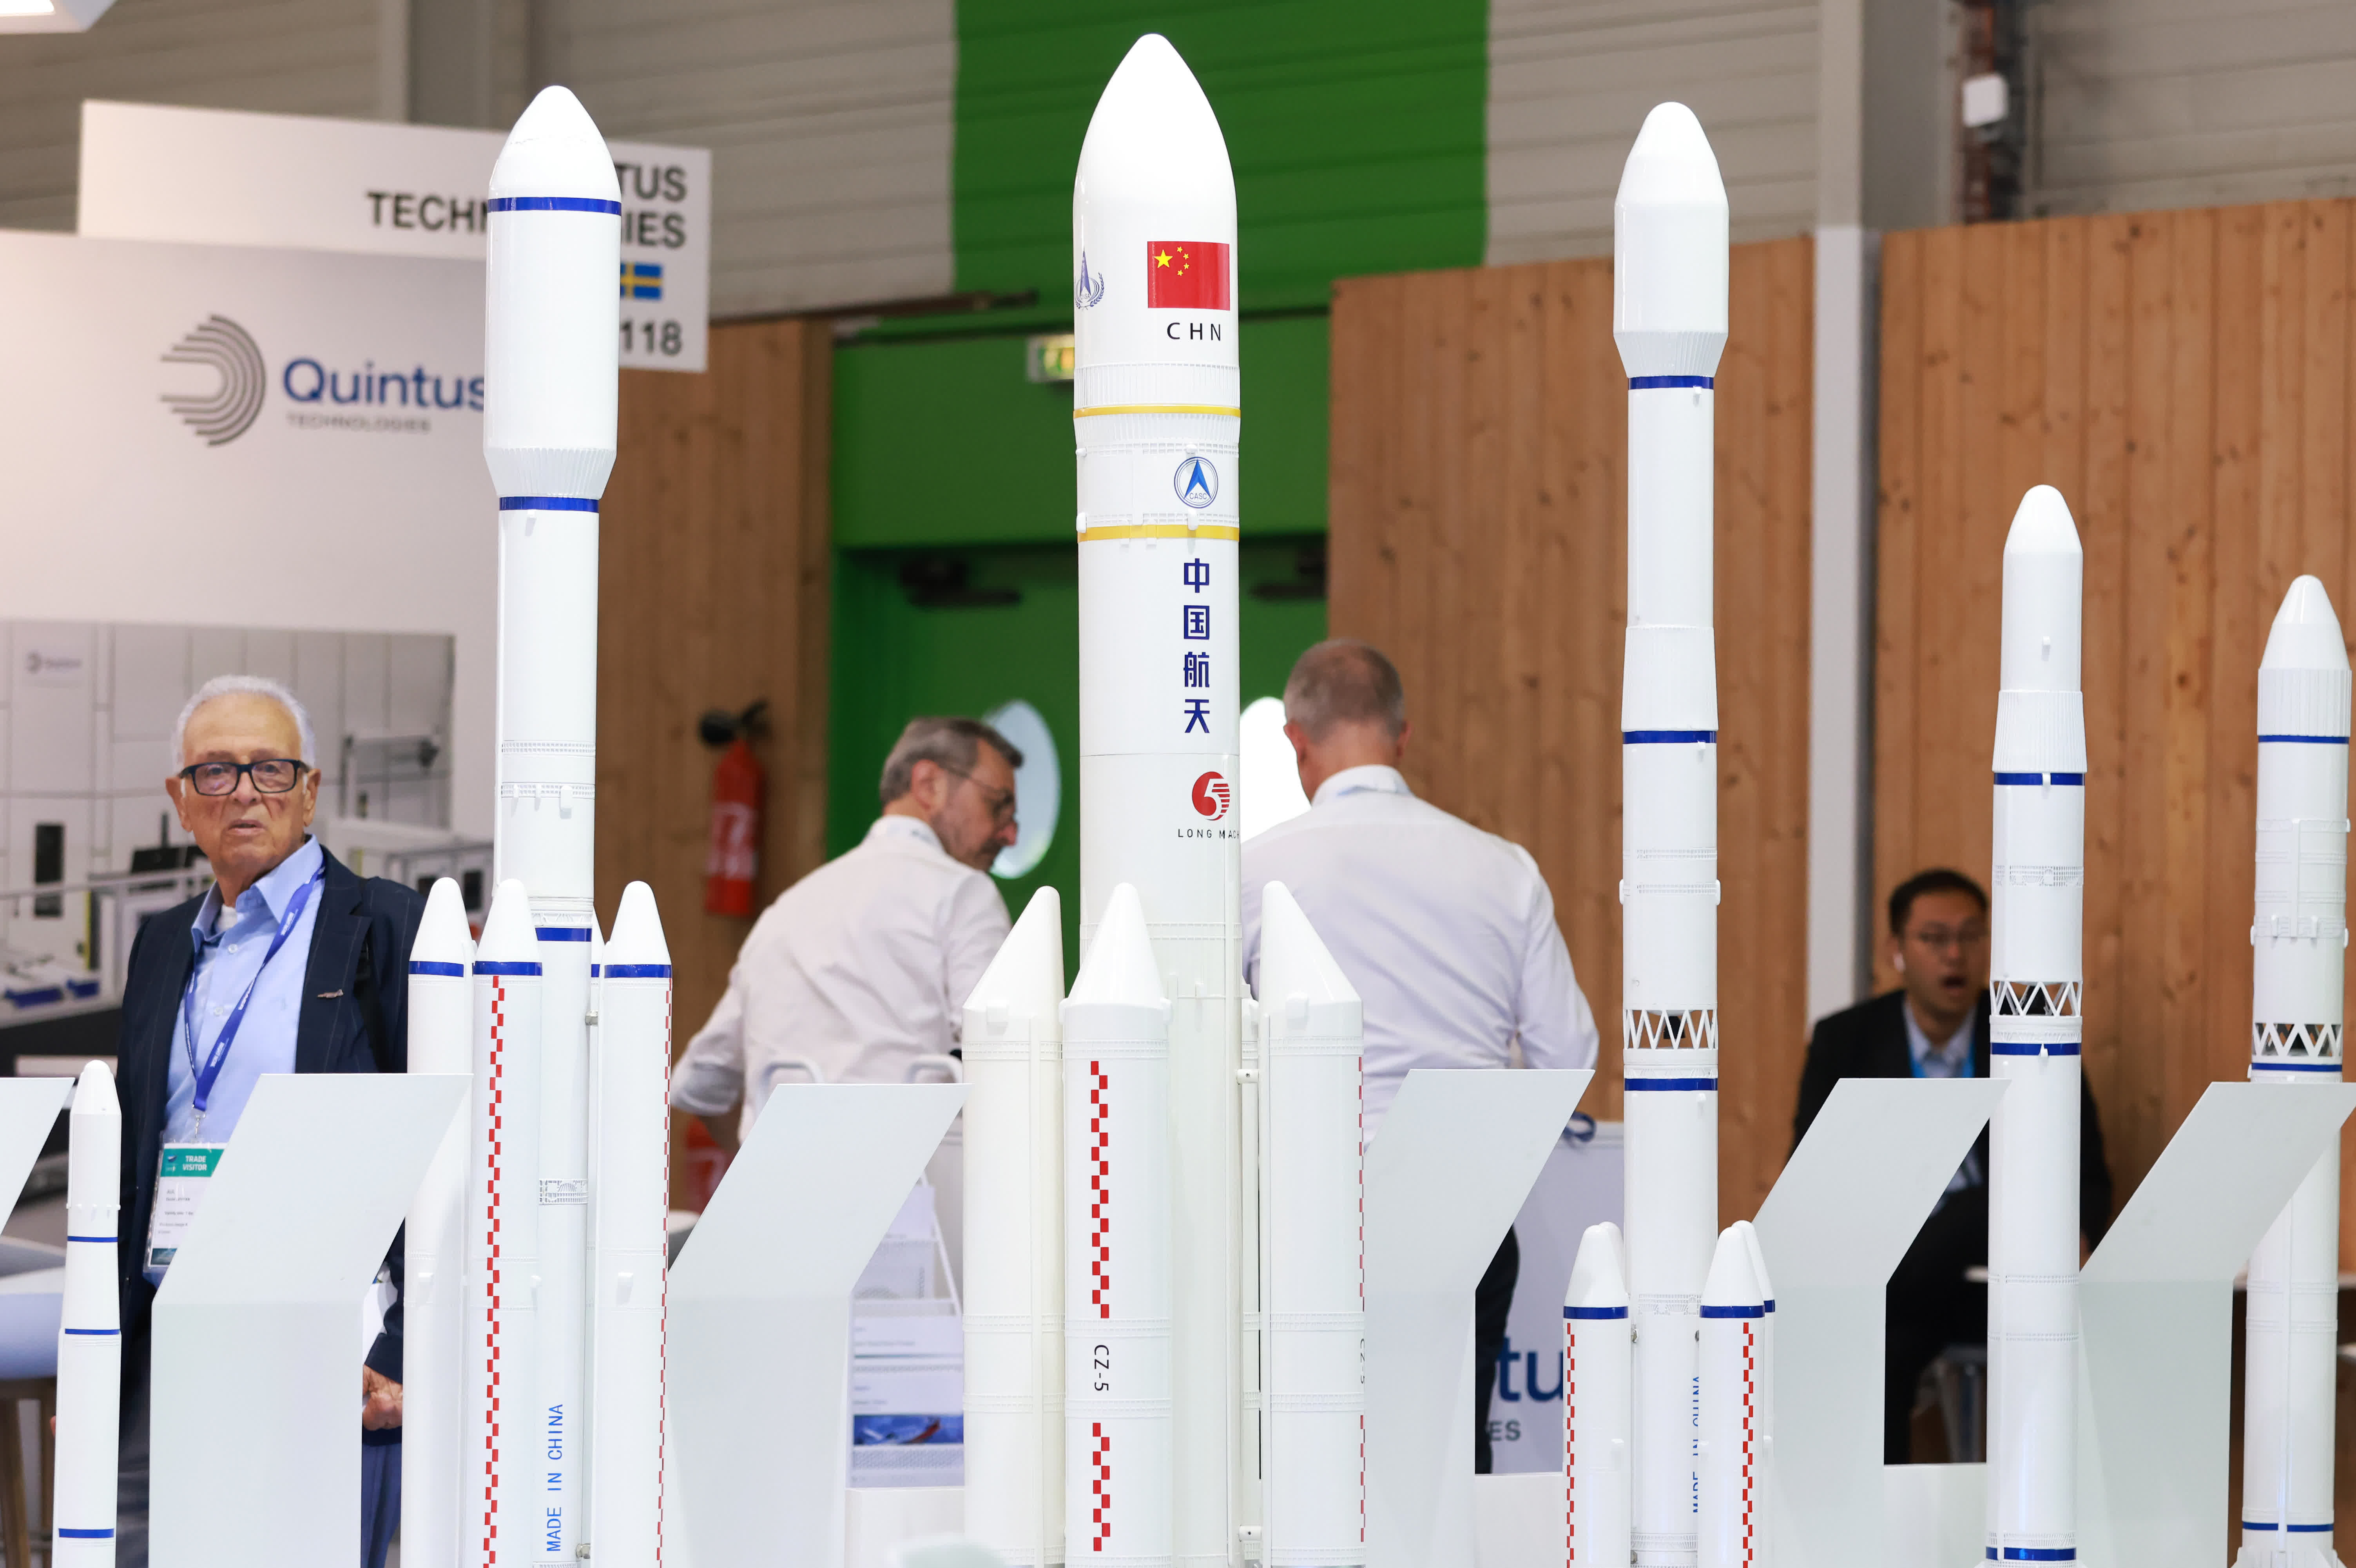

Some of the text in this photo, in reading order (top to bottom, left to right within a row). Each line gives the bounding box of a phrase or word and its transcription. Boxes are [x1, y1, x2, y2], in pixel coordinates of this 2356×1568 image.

[1167, 322, 1221, 341] CHN
[283, 358, 484, 414] Quintus
[1183, 558, 1210, 733] 中国航天
[1178, 829, 1212, 839] LONG
[1094, 1345, 1109, 1391] CZ-5
[547, 1404, 563, 1552] MADE IN CHINA
